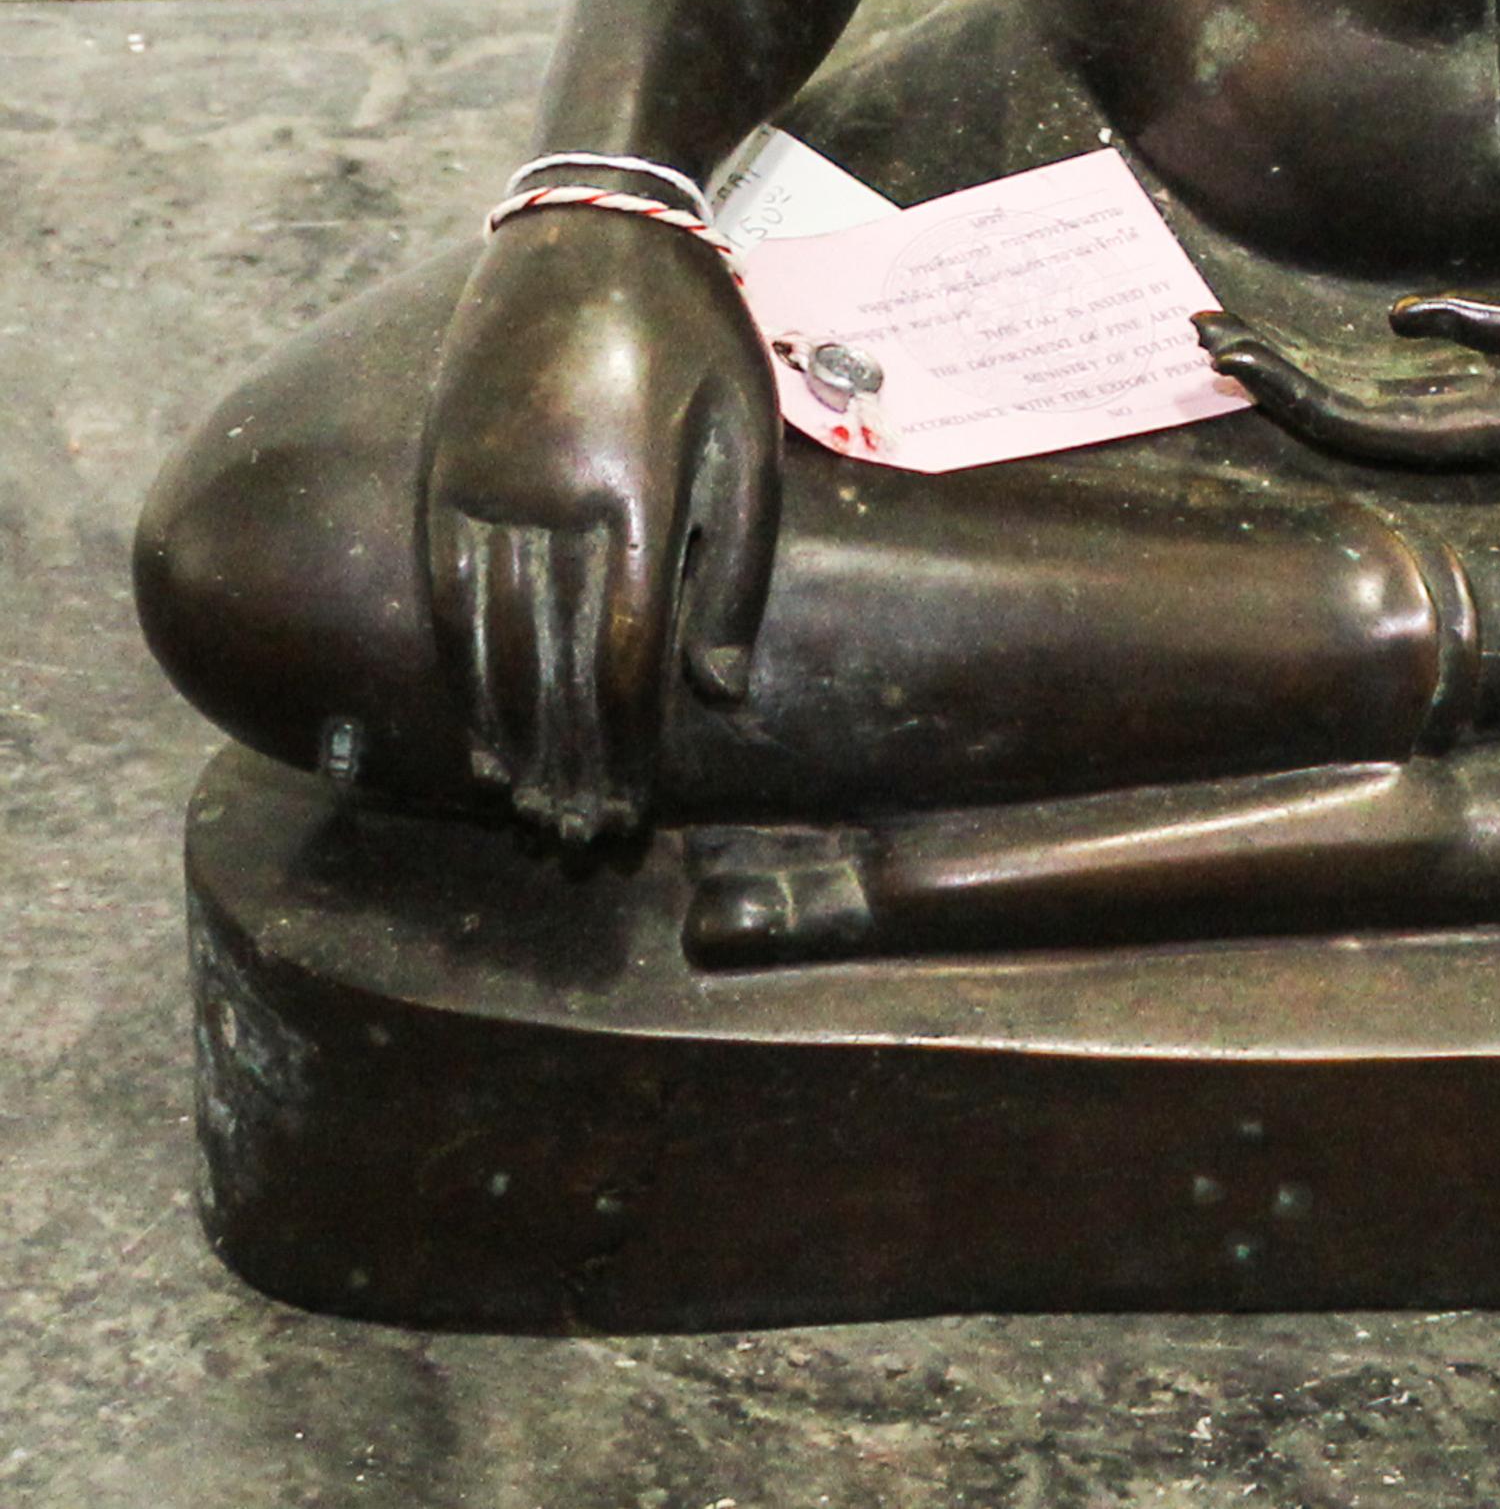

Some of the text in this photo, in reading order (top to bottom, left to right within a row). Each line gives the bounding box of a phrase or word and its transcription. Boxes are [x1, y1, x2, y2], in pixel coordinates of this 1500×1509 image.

[1148, 280, 1170, 295] BY
[928, 363, 957, 382] THE
[1078, 328, 1099, 344] OF
[1106, 317, 1142, 337] FINE
[1149, 304, 1190, 323] ARTS
[1023, 332, 1196, 387] MINISTRY OF CULTUR
[1012, 393, 1057, 415] WITH
[1061, 386, 1091, 404] THE
[1096, 370, 1159, 396] EXPORT
